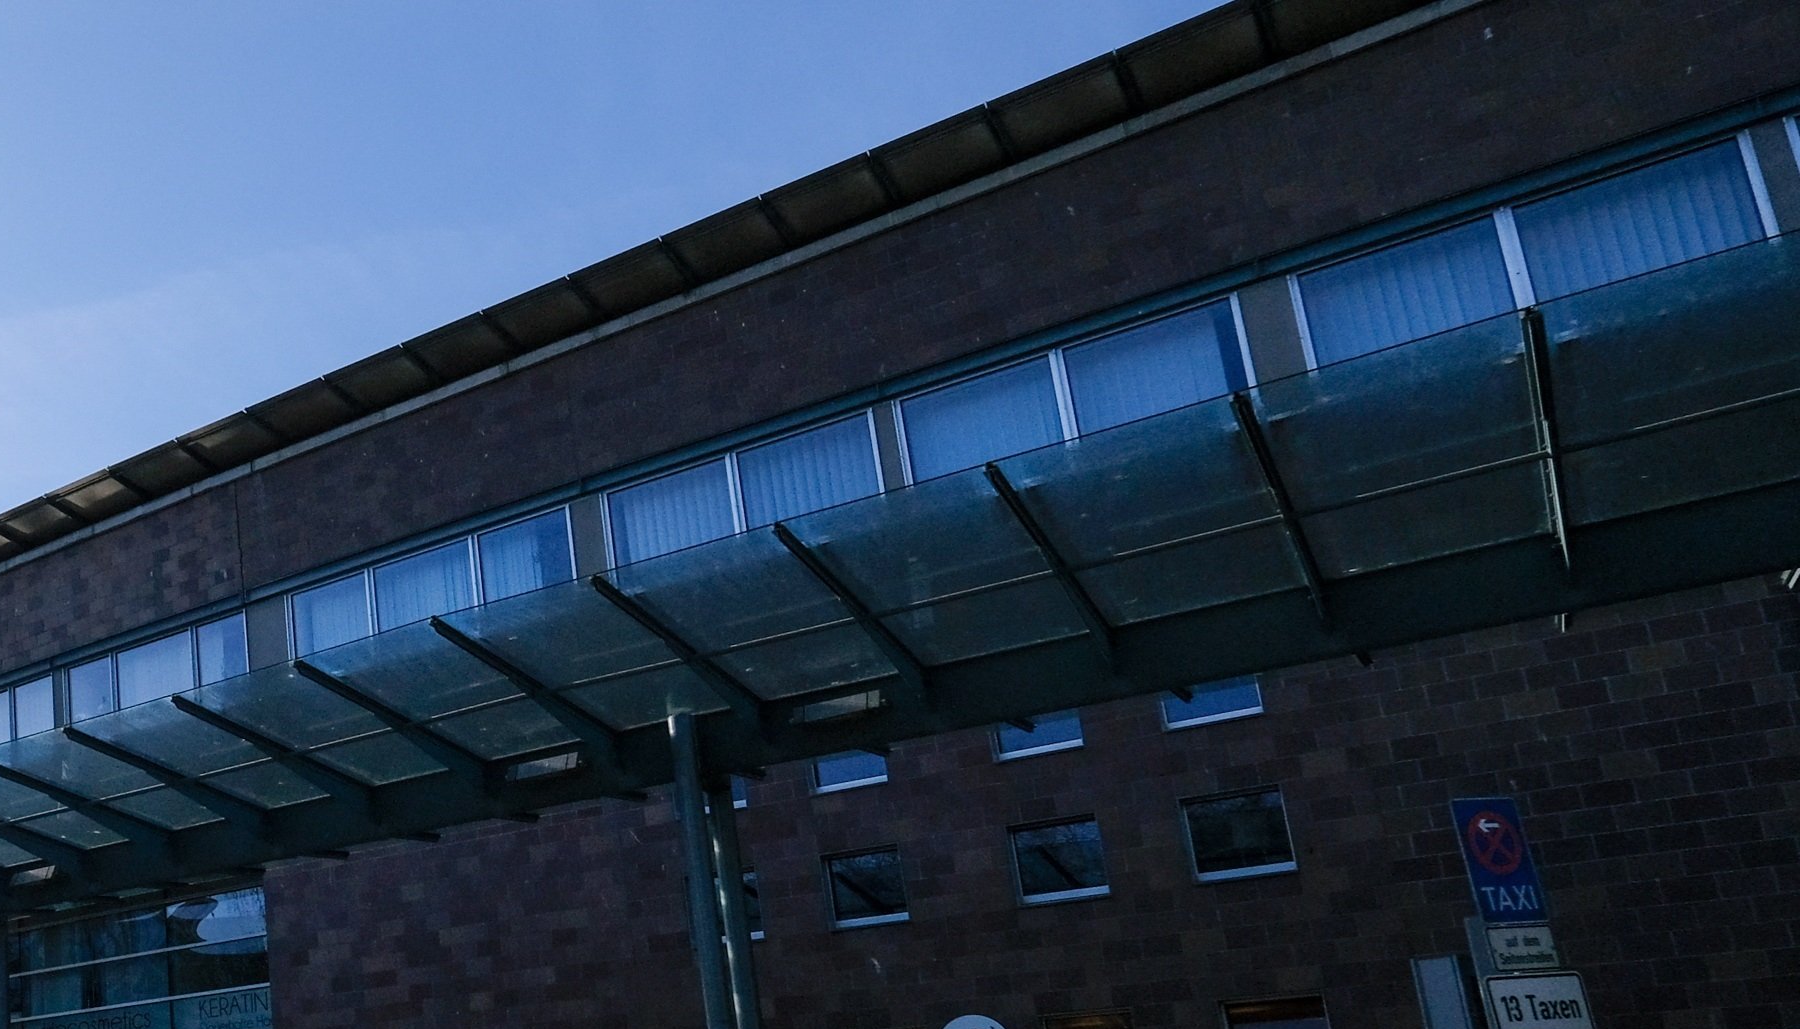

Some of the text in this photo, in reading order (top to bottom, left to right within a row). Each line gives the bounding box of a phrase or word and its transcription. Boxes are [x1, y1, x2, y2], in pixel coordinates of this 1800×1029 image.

[1480, 885, 1539, 912] TAXI
[199, 991, 269, 1019] KERATIN
[1500, 994, 1583, 1022] 13 Taxen
